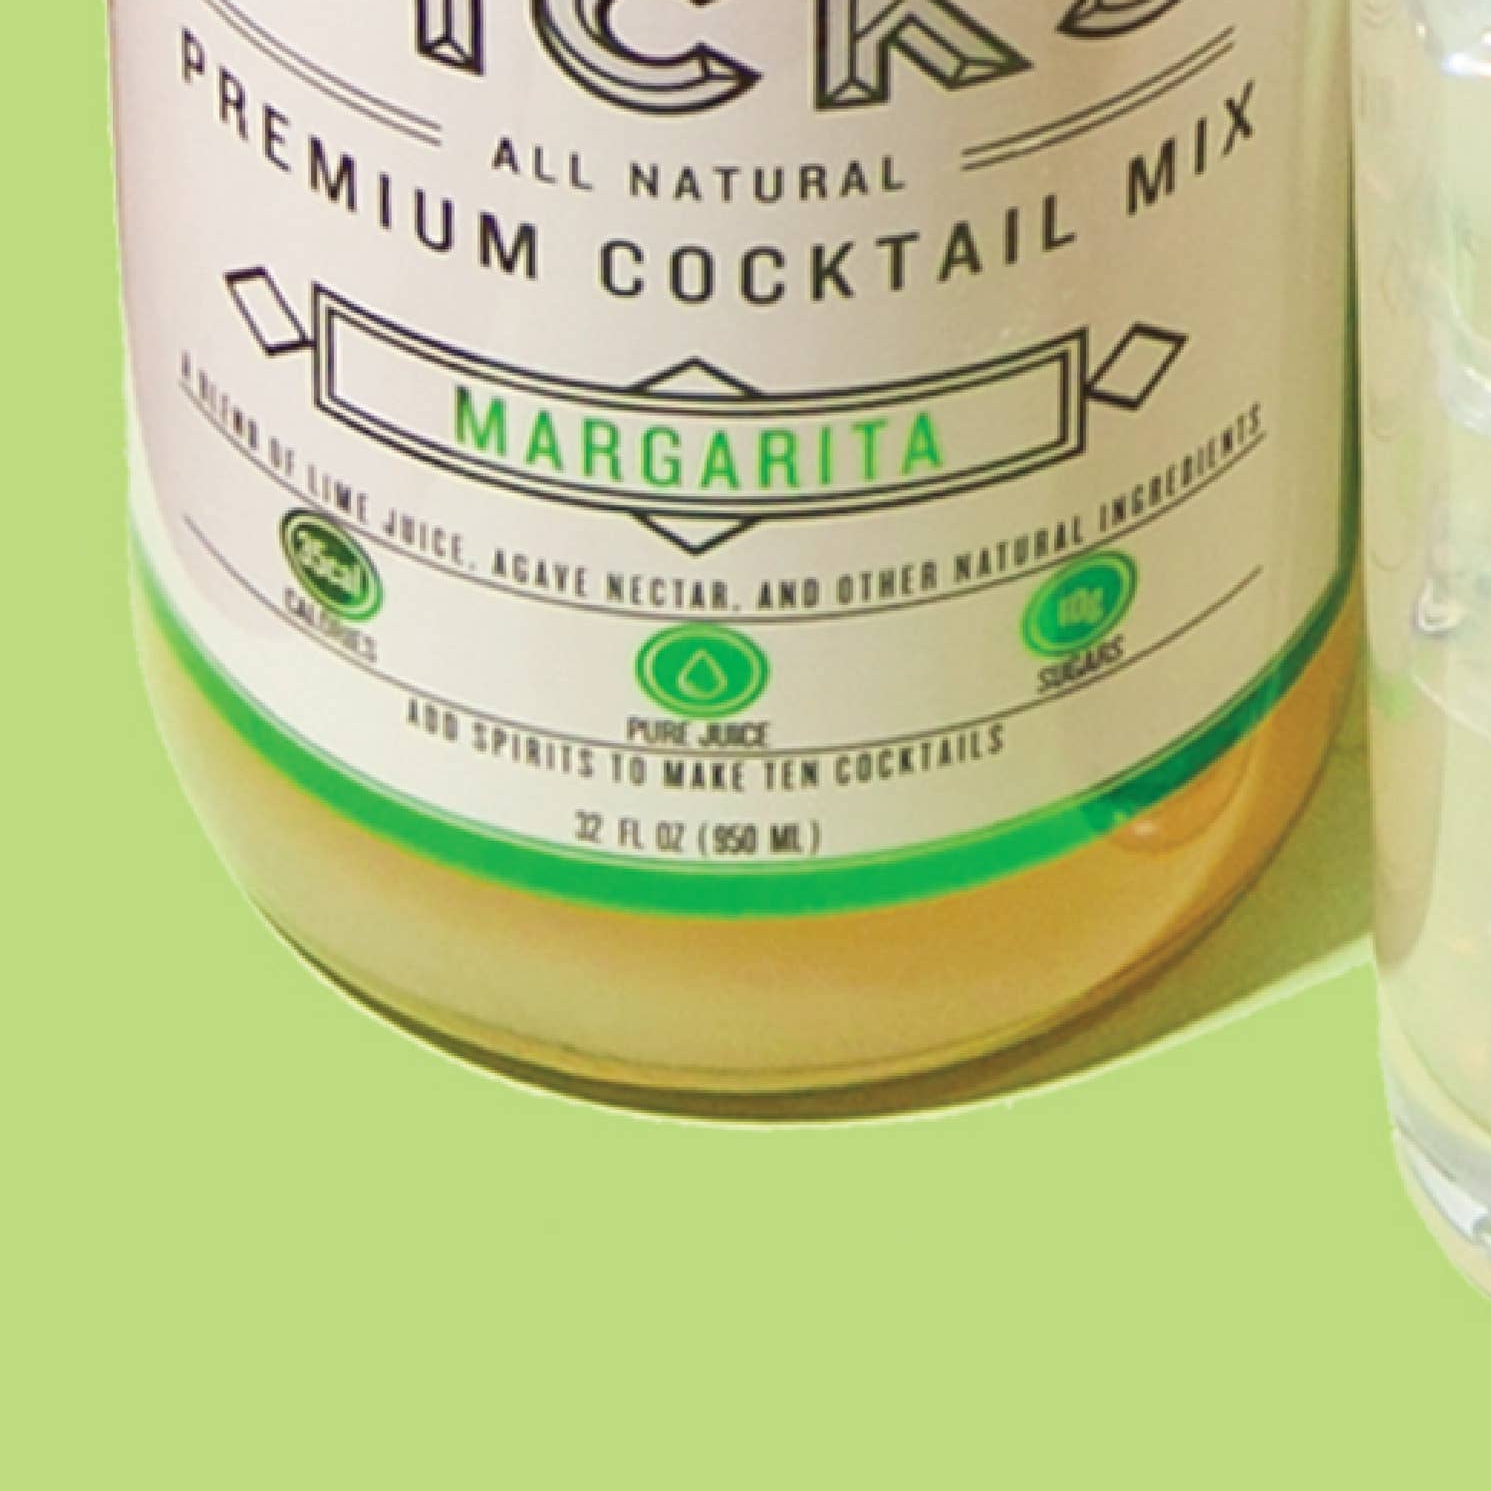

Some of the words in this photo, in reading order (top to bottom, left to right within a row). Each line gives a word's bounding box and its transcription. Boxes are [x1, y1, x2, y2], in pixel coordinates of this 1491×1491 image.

[180, 26, 539, 281] PREMIUM
[599, 194, 1077, 306] COCKTAIL
[1127, 79, 1255, 218] MIX
[491, 135, 595, 193] ALL
[629, 155, 905, 204] NATURAL
[452, 385, 943, 489] MARGARITA
[268, 437, 294, 476] OF
[307, 464, 369, 524] LIME
[491, 548, 588, 597] AGAVE
[757, 577, 817, 610] AND
[837, 559, 938, 605] OTHER
[953, 515, 1084, 582] NATURAL
[1099, 402, 1262, 531] INGREDIENTS
[1037, 634, 1124, 694] SUGARS
[405, 698, 460, 741] ADD
[471, 723, 594, 779] SPIRITS
[610, 753, 646, 787] TO
[662, 760, 746, 792] MAKE
[763, 759, 819, 792] TEN
[834, 723, 1006, 788] COCKTAILS
[626, 716, 688, 746] PURE
[697, 721, 769, 747] JUICE
[574, 808, 605, 843] 32
[618, 816, 644, 850] FL
[656, 820, 687, 853] OZ
